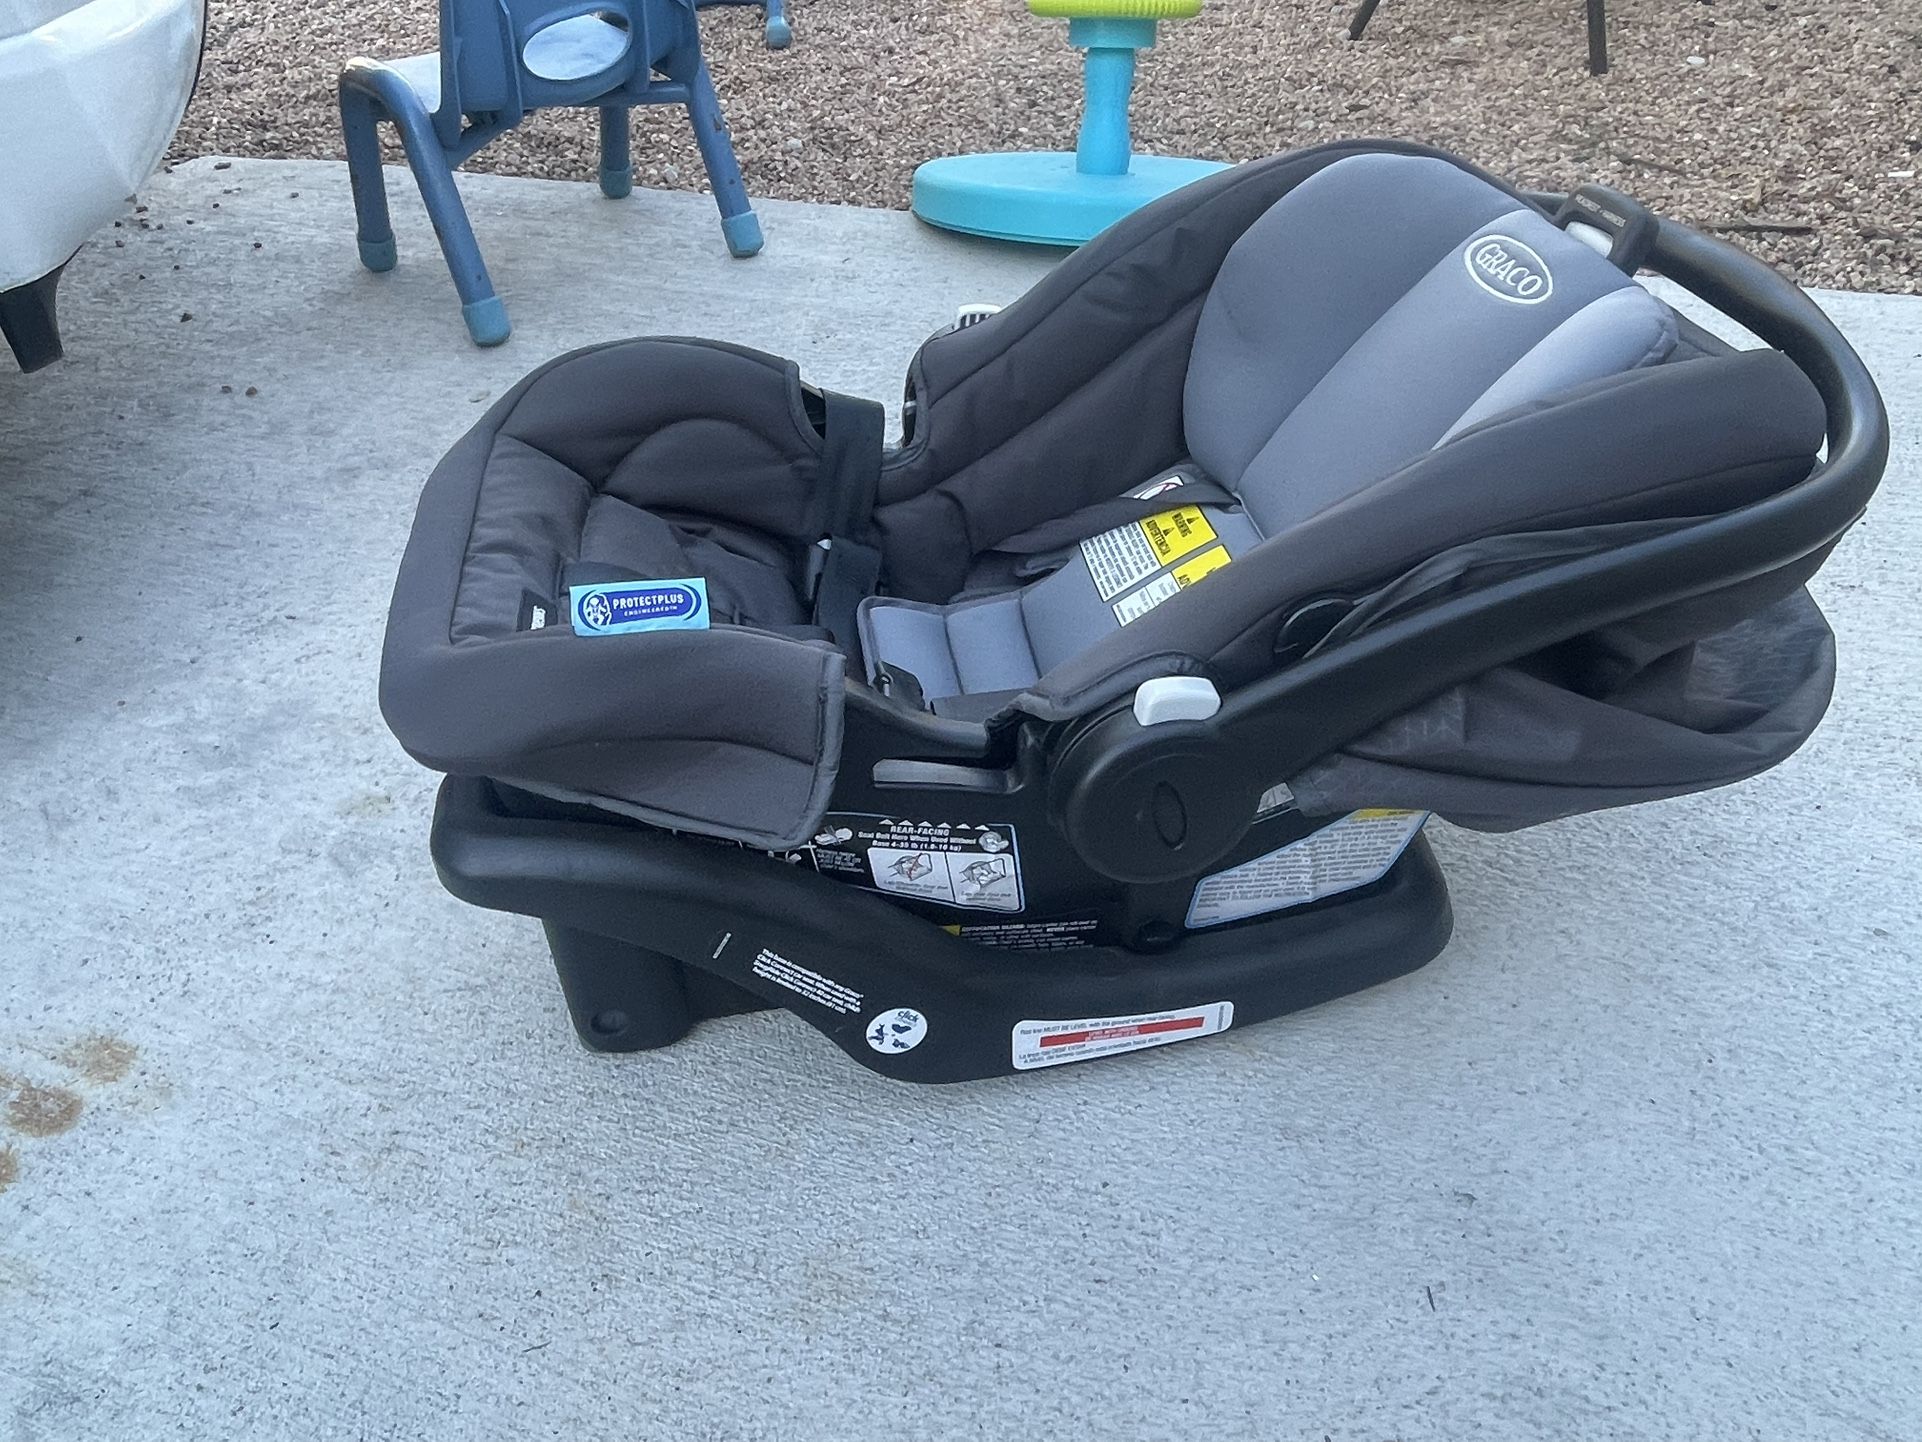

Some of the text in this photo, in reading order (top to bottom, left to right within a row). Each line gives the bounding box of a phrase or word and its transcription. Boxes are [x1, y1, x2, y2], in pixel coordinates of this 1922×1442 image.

[1475, 243, 1543, 295] GRACO
[1172, 512, 1192, 538] WARNING
[1145, 519, 1171, 557] ADVERTENCIA
[612, 593, 685, 610] PROTECTPLUS
[890, 825, 950, 836] REAR-FACING
[872, 839, 890, 847] Base
